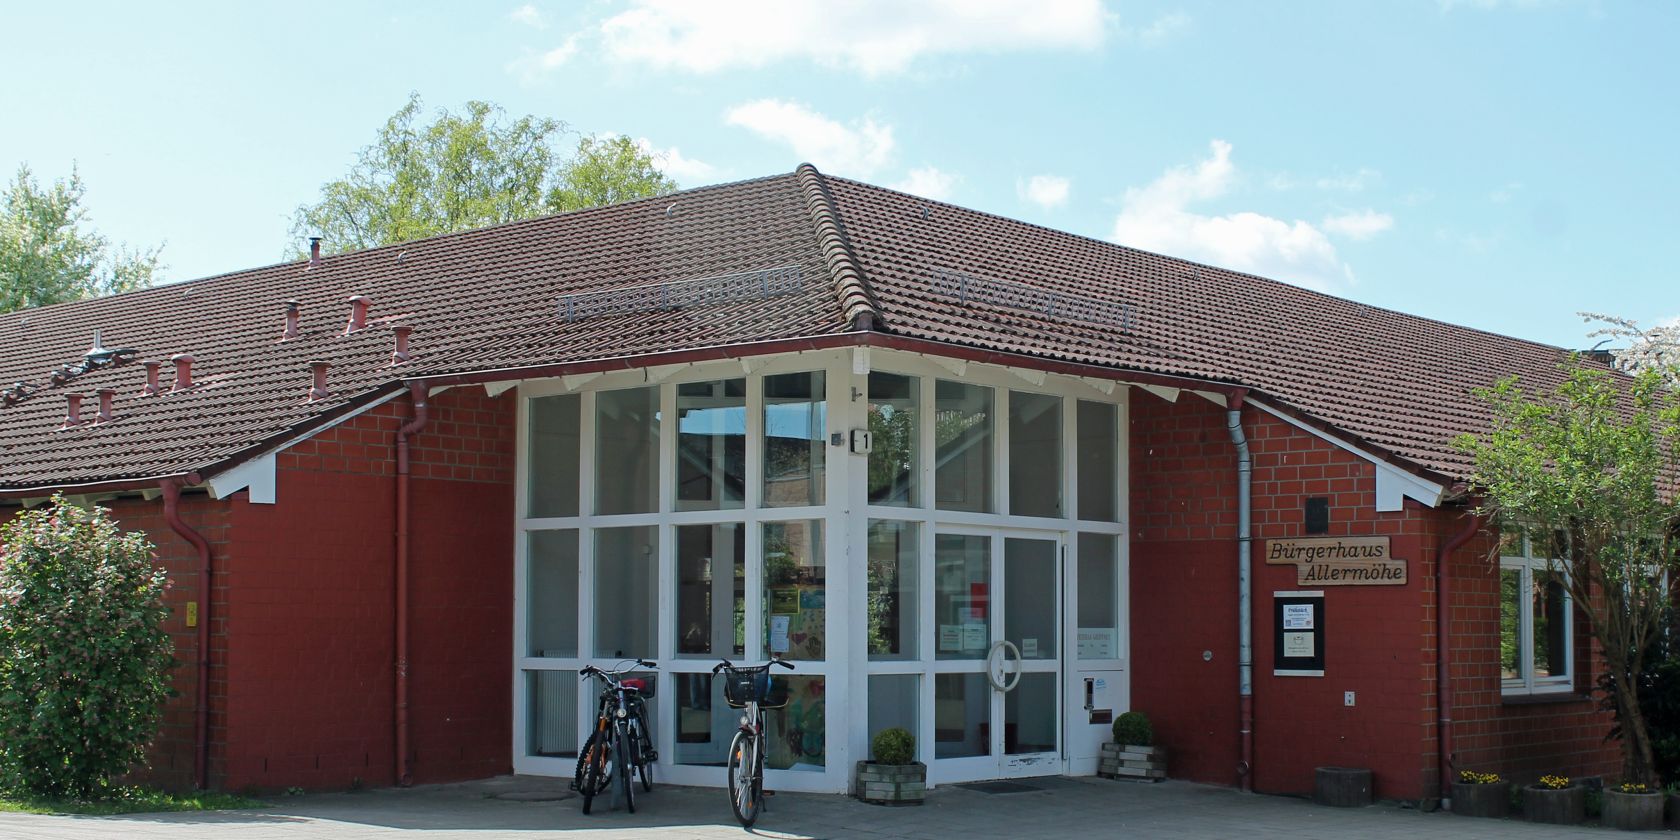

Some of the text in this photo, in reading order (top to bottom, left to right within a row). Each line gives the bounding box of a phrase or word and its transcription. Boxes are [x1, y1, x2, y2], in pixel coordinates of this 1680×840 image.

[863, 433, 868, 450] 1
[1269, 541, 1384, 563] Bürgerhaus
[1303, 563, 1403, 581] Allermöhe
